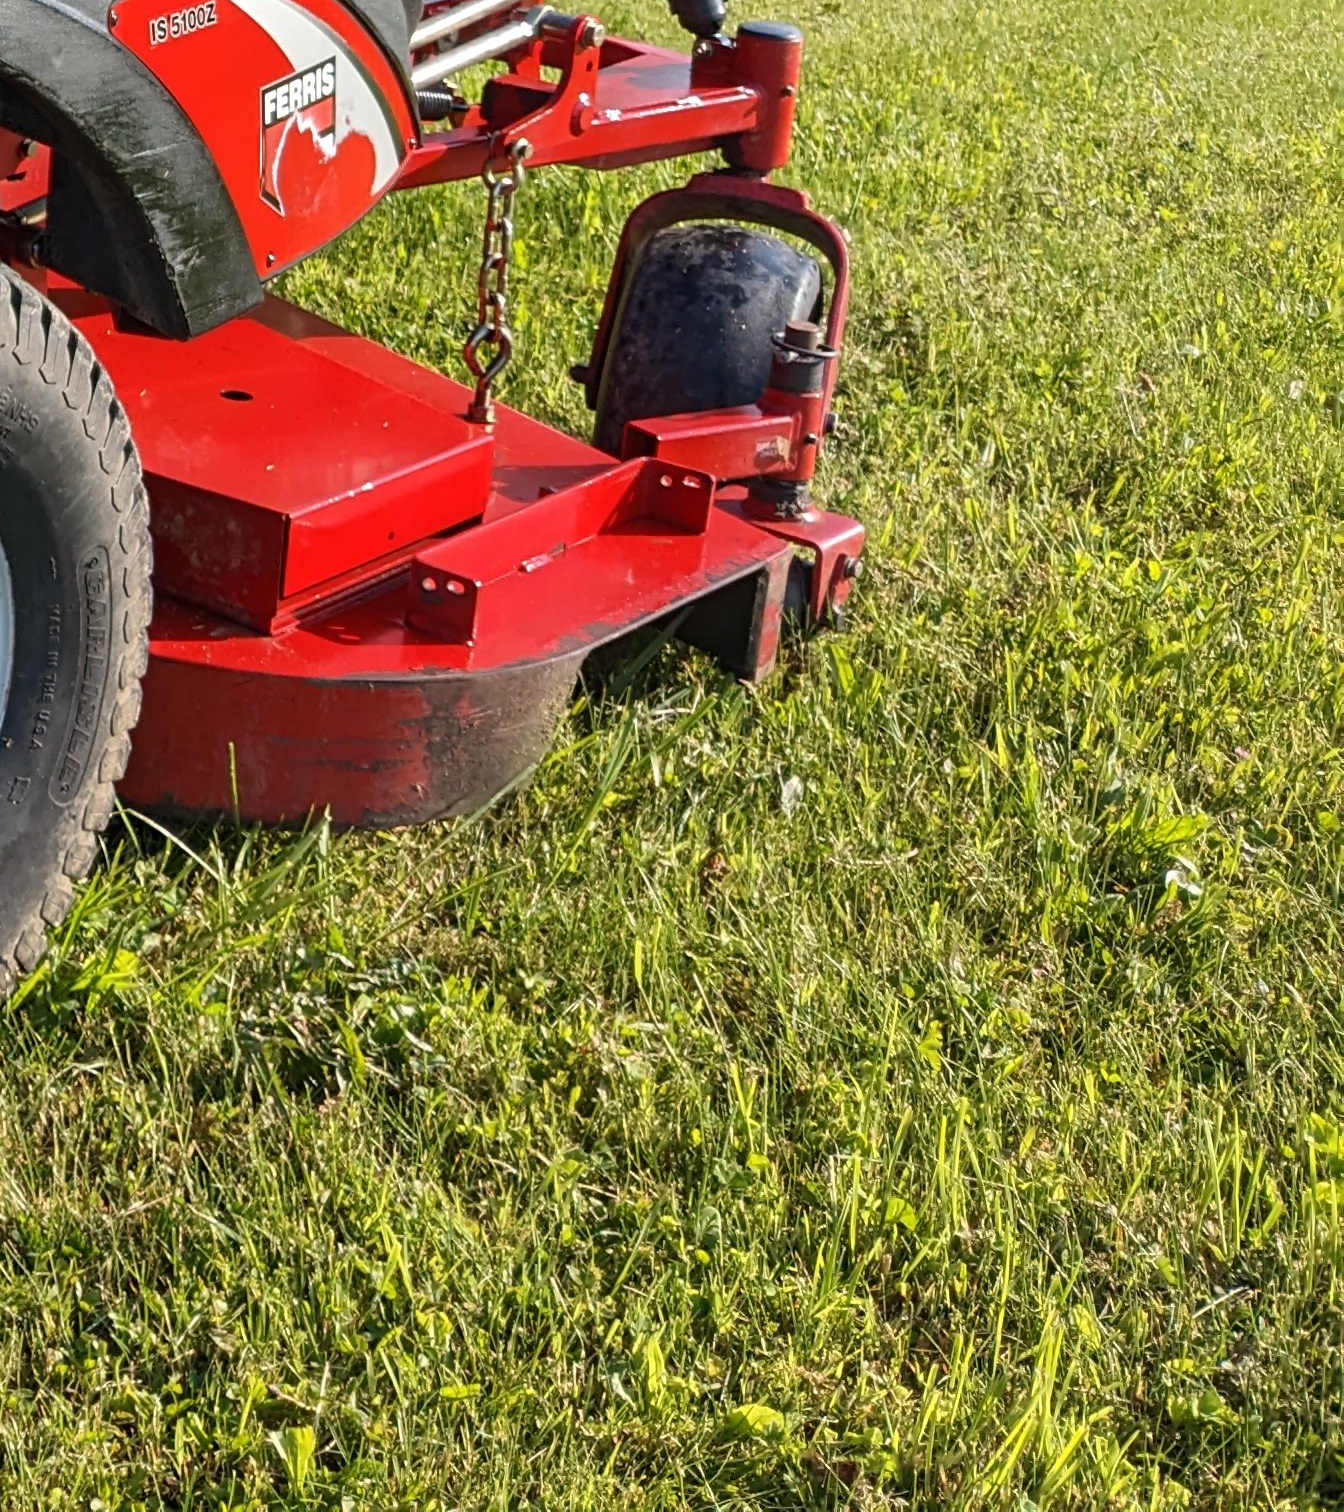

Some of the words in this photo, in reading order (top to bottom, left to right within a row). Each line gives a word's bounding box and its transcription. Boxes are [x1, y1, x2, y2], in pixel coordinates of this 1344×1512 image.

[150, 17, 167, 44] IS
[171, 1, 217, 36] 5100Z
[264, 62, 335, 126] FERRIS
[47, 602, 61, 643] MADE
[47, 650, 59, 667] IN
[61, 568, 107, 783] CARLISLE
[42, 673, 58, 702] THE
